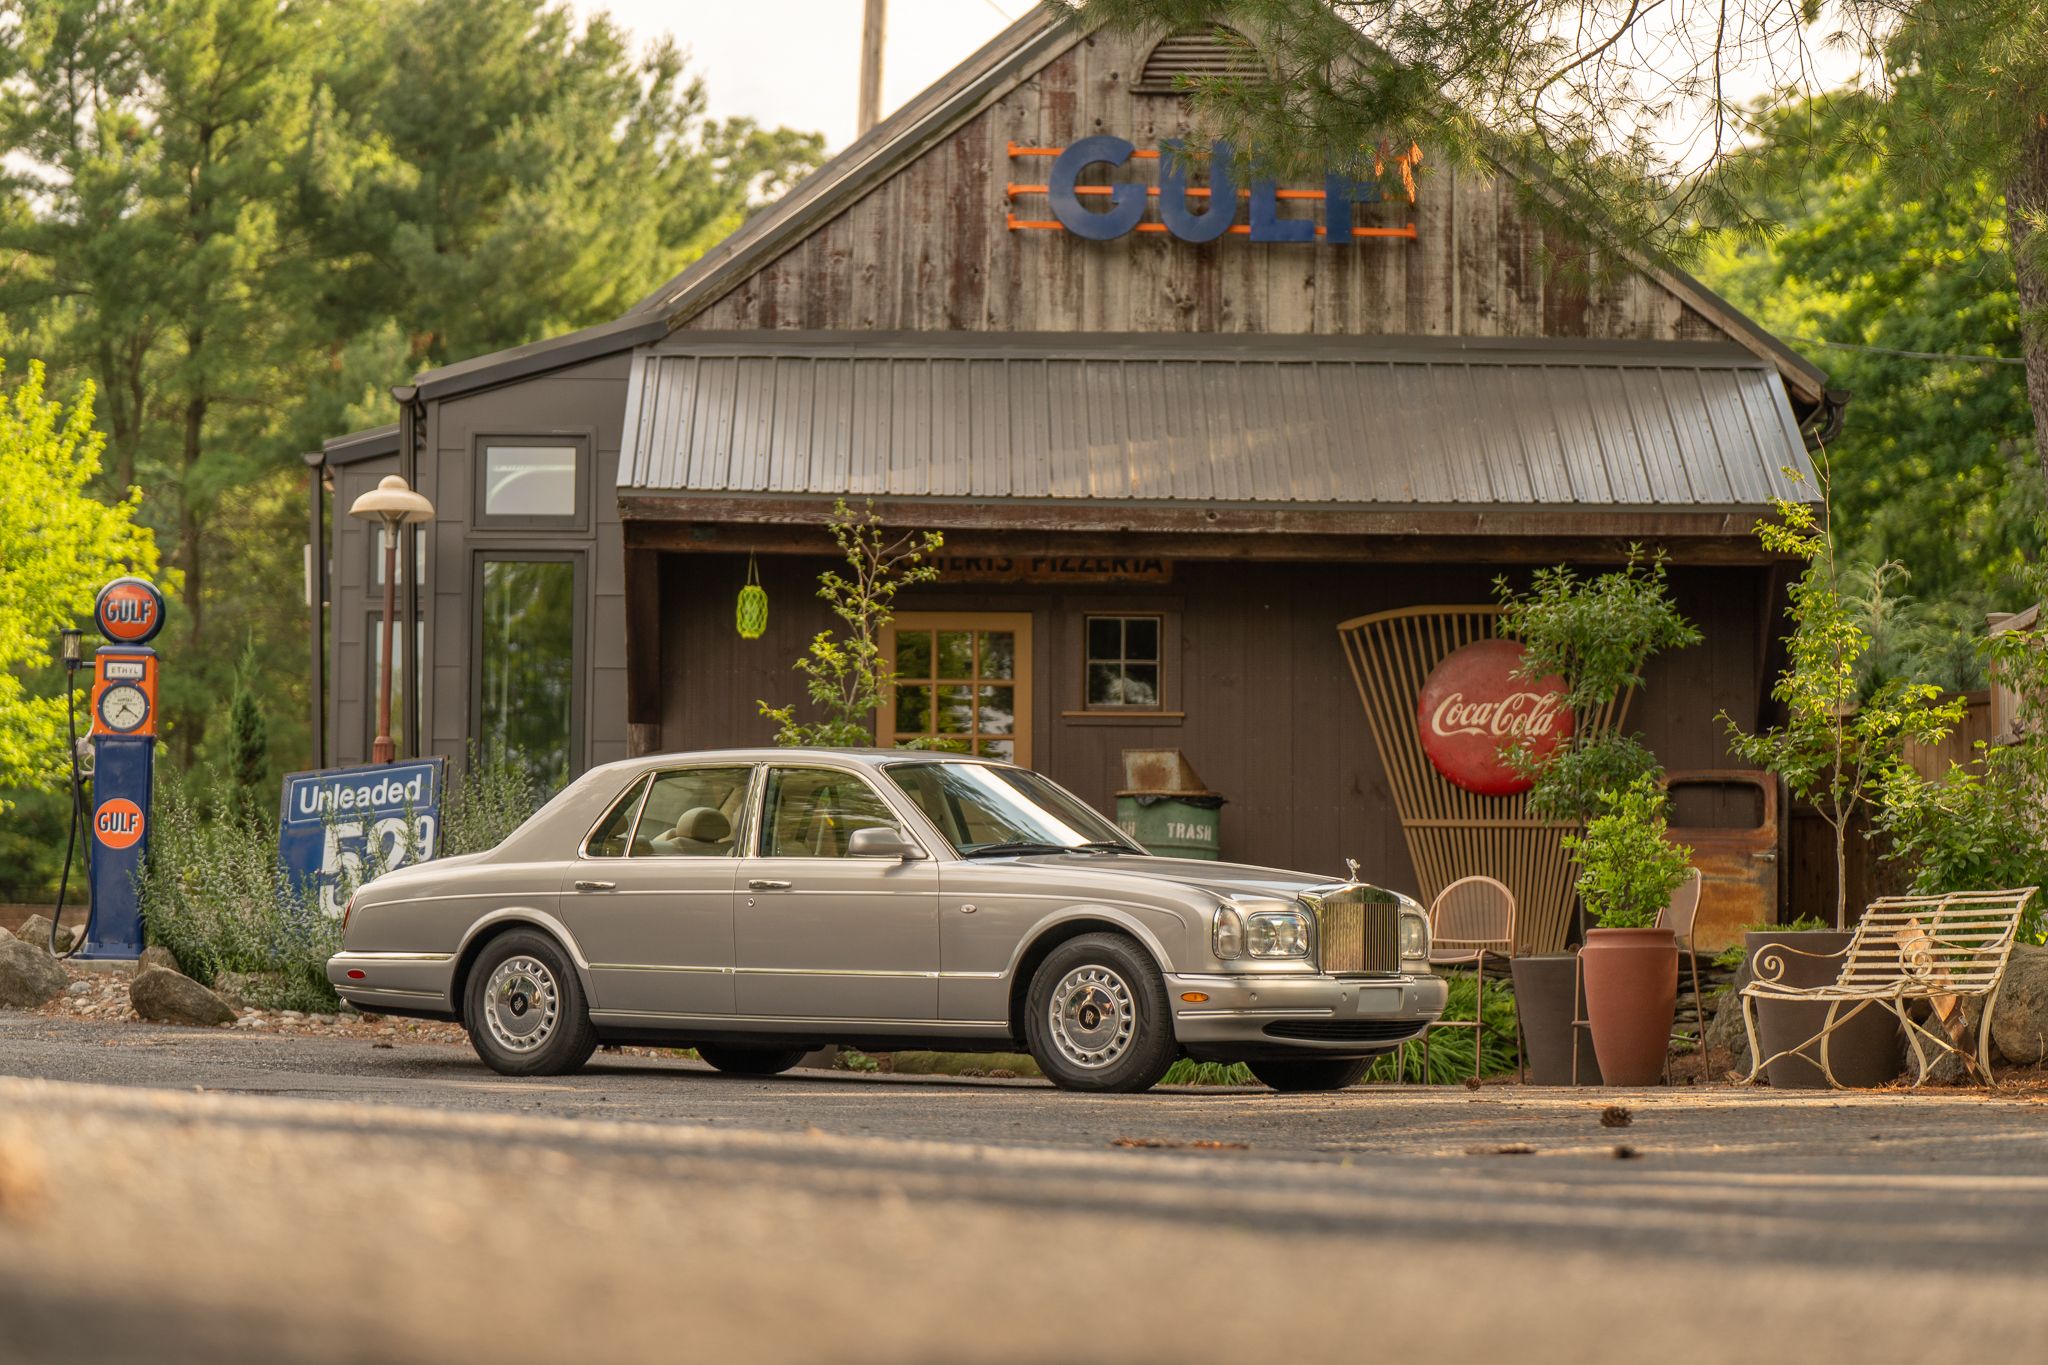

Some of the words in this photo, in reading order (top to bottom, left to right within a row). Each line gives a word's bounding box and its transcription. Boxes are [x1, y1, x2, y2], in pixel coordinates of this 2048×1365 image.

[1031, 556, 1164, 574] PIZZERIA
[105, 599, 153, 624] GULF
[111, 665, 139, 675] ETHYL
[300, 773, 423, 814] Unleaded
[98, 811, 140, 834] GULF
[1167, 822, 1212, 841] TRASH
